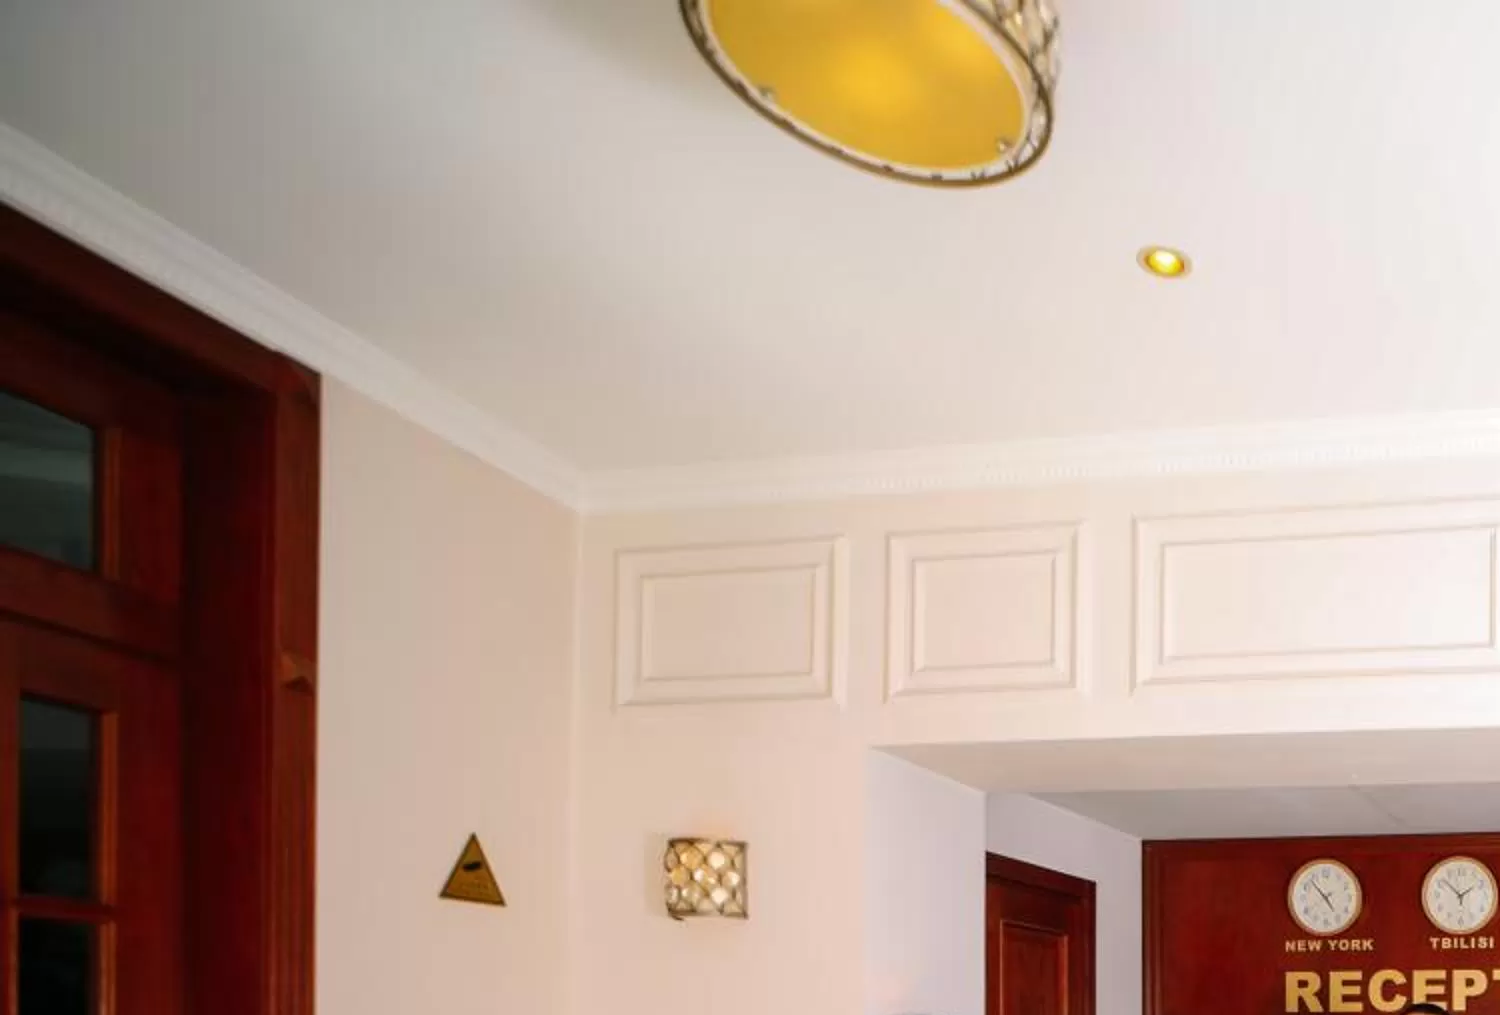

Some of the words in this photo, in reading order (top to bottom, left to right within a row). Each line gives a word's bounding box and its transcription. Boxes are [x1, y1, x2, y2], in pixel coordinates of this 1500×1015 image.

[1285, 939, 1321, 952] NEW
[1327, 939, 1374, 951] YORK
[1429, 936, 1494, 949] TBILISI
